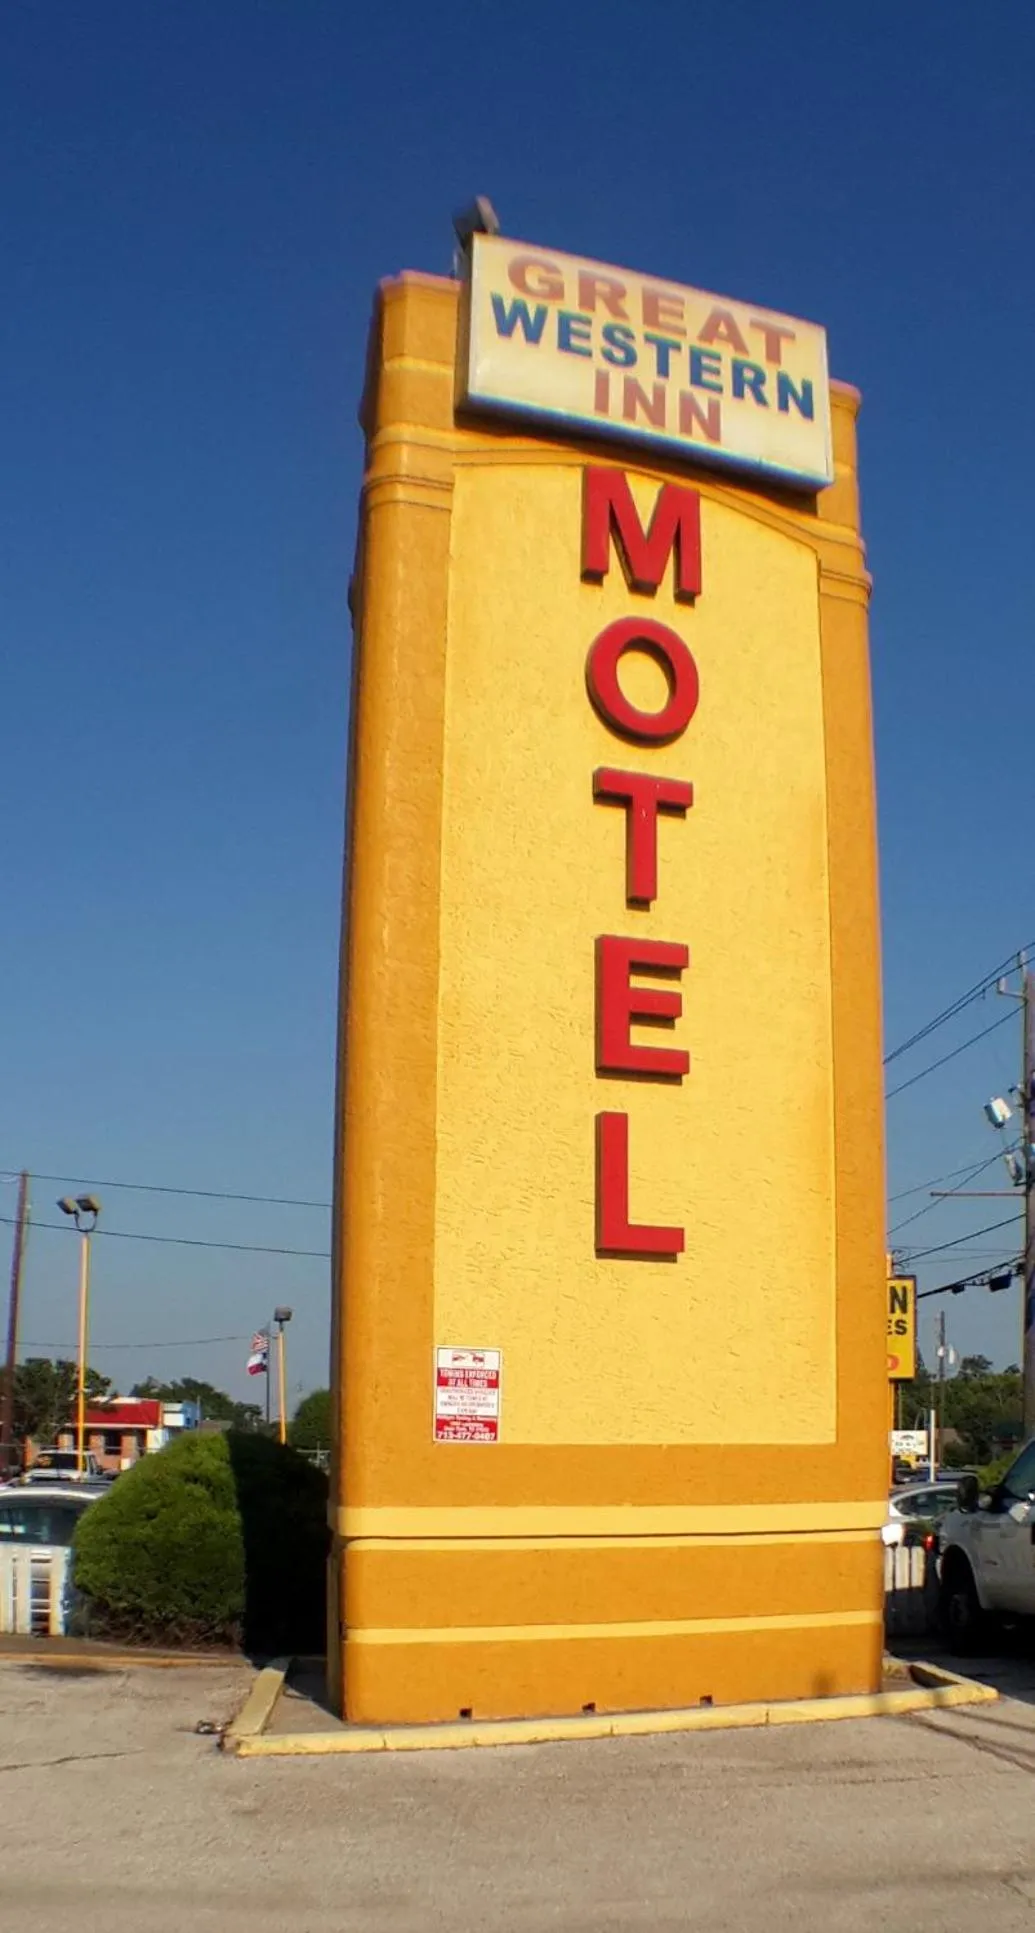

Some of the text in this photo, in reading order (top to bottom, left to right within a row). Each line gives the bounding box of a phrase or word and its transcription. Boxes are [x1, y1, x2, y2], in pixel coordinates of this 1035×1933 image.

[490, 291, 815, 422] WESTERN
[507, 254, 796, 366] GREAT
[594, 368, 722, 443] INN
[580, 464, 702, 1263] MOTEL
